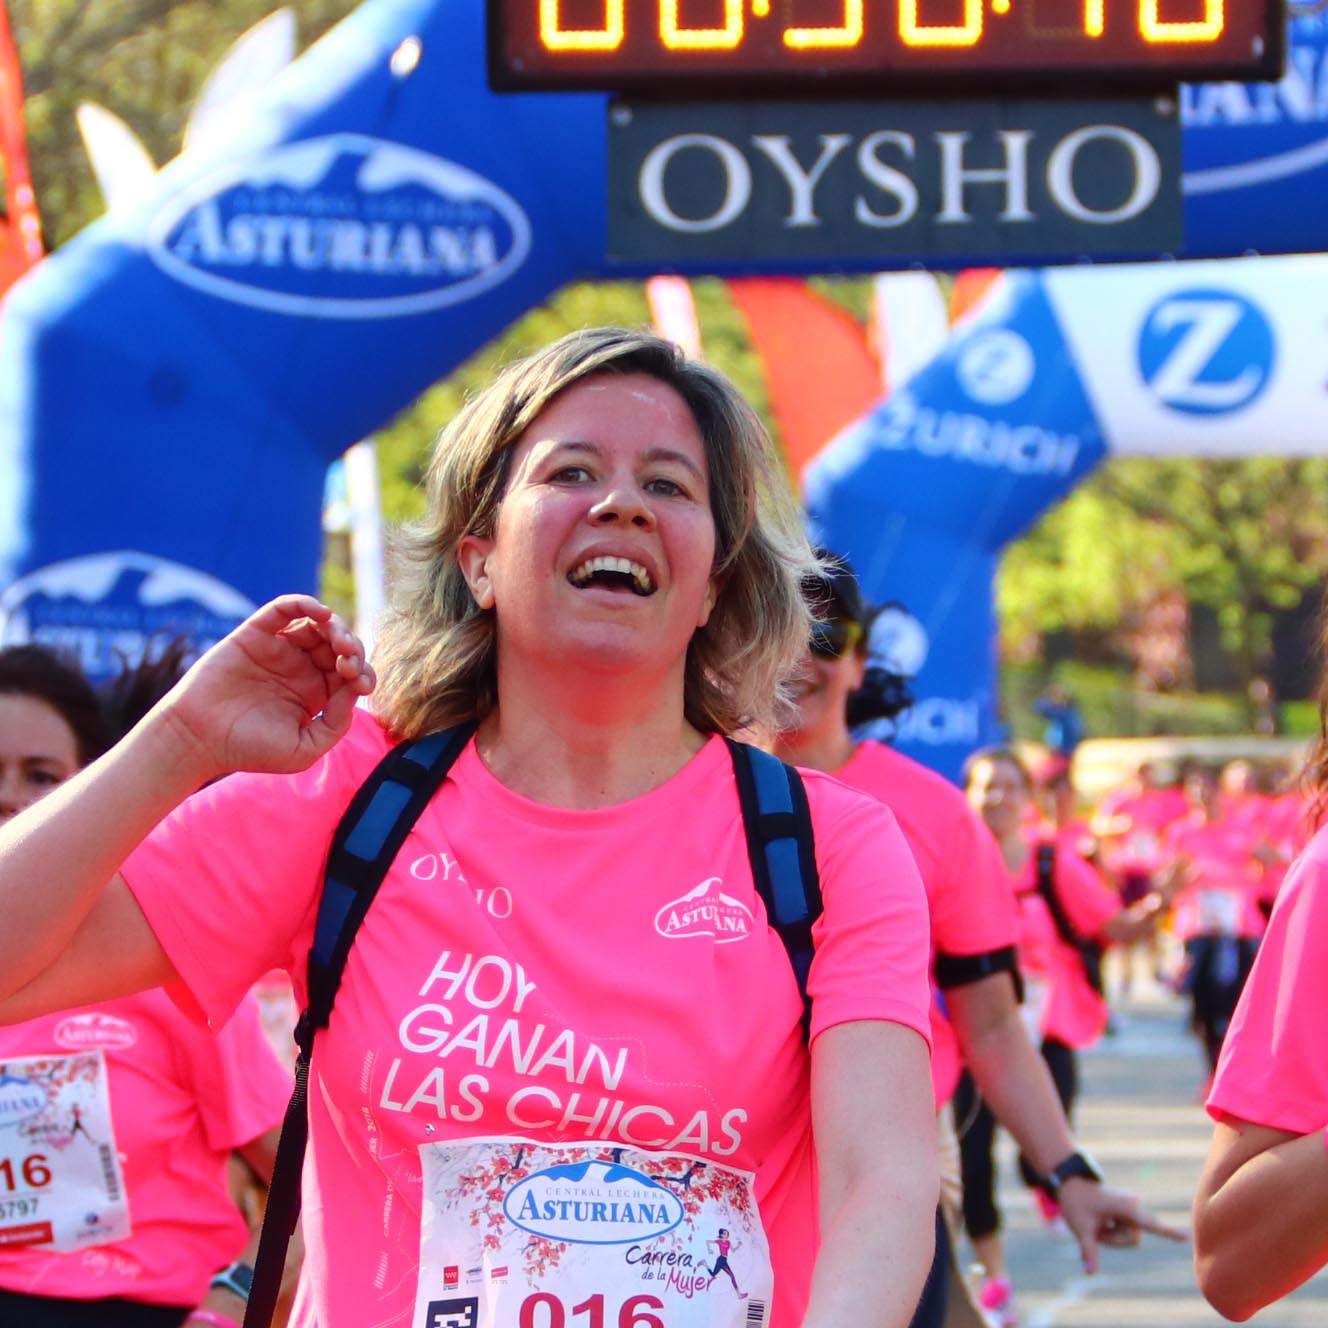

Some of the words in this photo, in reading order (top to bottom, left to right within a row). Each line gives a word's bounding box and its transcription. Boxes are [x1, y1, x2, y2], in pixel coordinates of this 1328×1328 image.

[639, 125, 1161, 231] OYSHO
[173, 197, 499, 276] ASTURIANA
[409, 852, 513, 919] OYO
[418, 950, 537, 1013] HOY
[397, 1004, 628, 1091] GANAN
[379, 1057, 489, 1122] LAS
[505, 1086, 747, 1157] CHICAS
[518, 1190, 670, 1225] ASTURIANA
[626, 1245, 693, 1267] Carrera
[665, 1267, 716, 1298] Mujer
